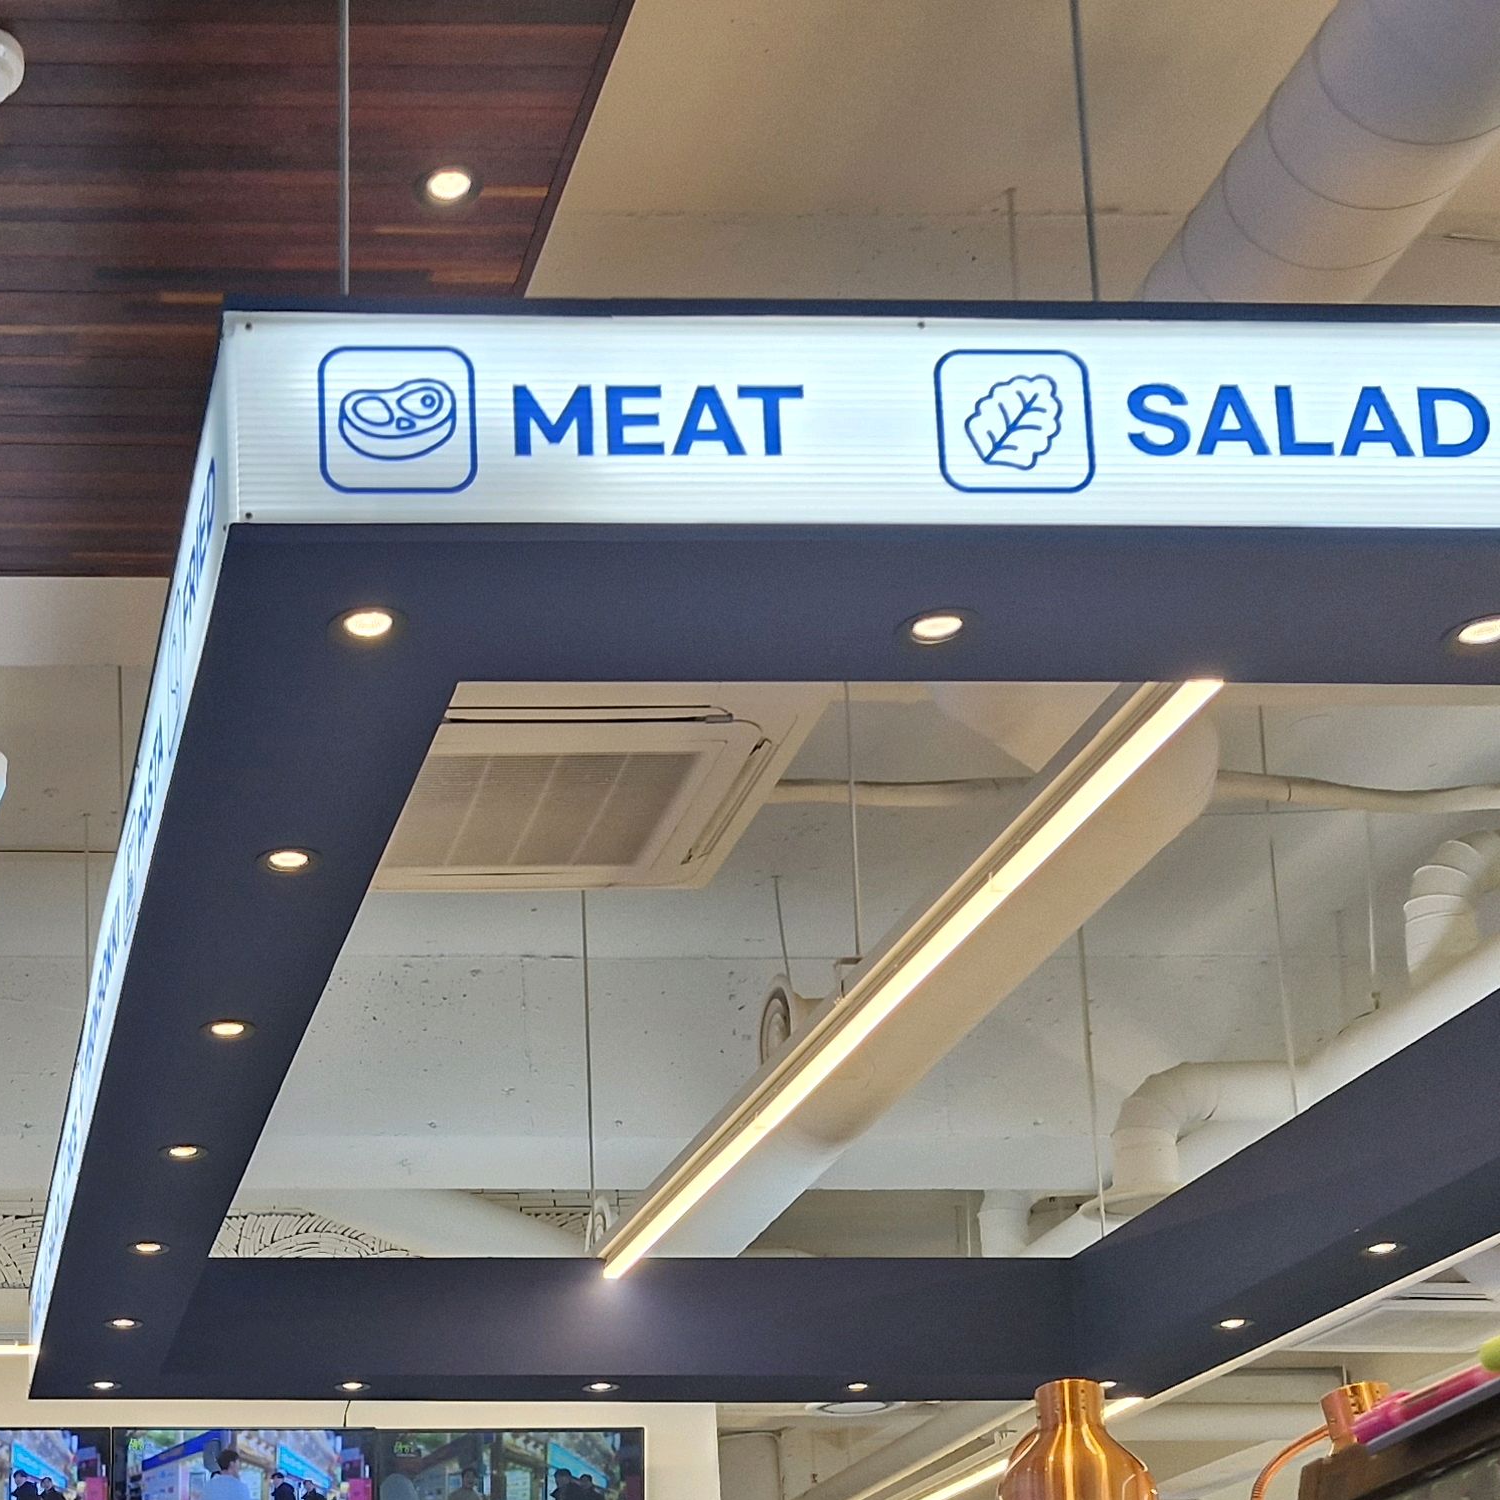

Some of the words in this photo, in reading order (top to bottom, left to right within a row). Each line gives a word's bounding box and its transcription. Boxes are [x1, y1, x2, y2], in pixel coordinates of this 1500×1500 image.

[512, 384, 804, 456] MEAT
[1127, 383, 1491, 457] SALAD
[182, 456, 216, 650] FRIED
[137, 714, 164, 864] PASTA
